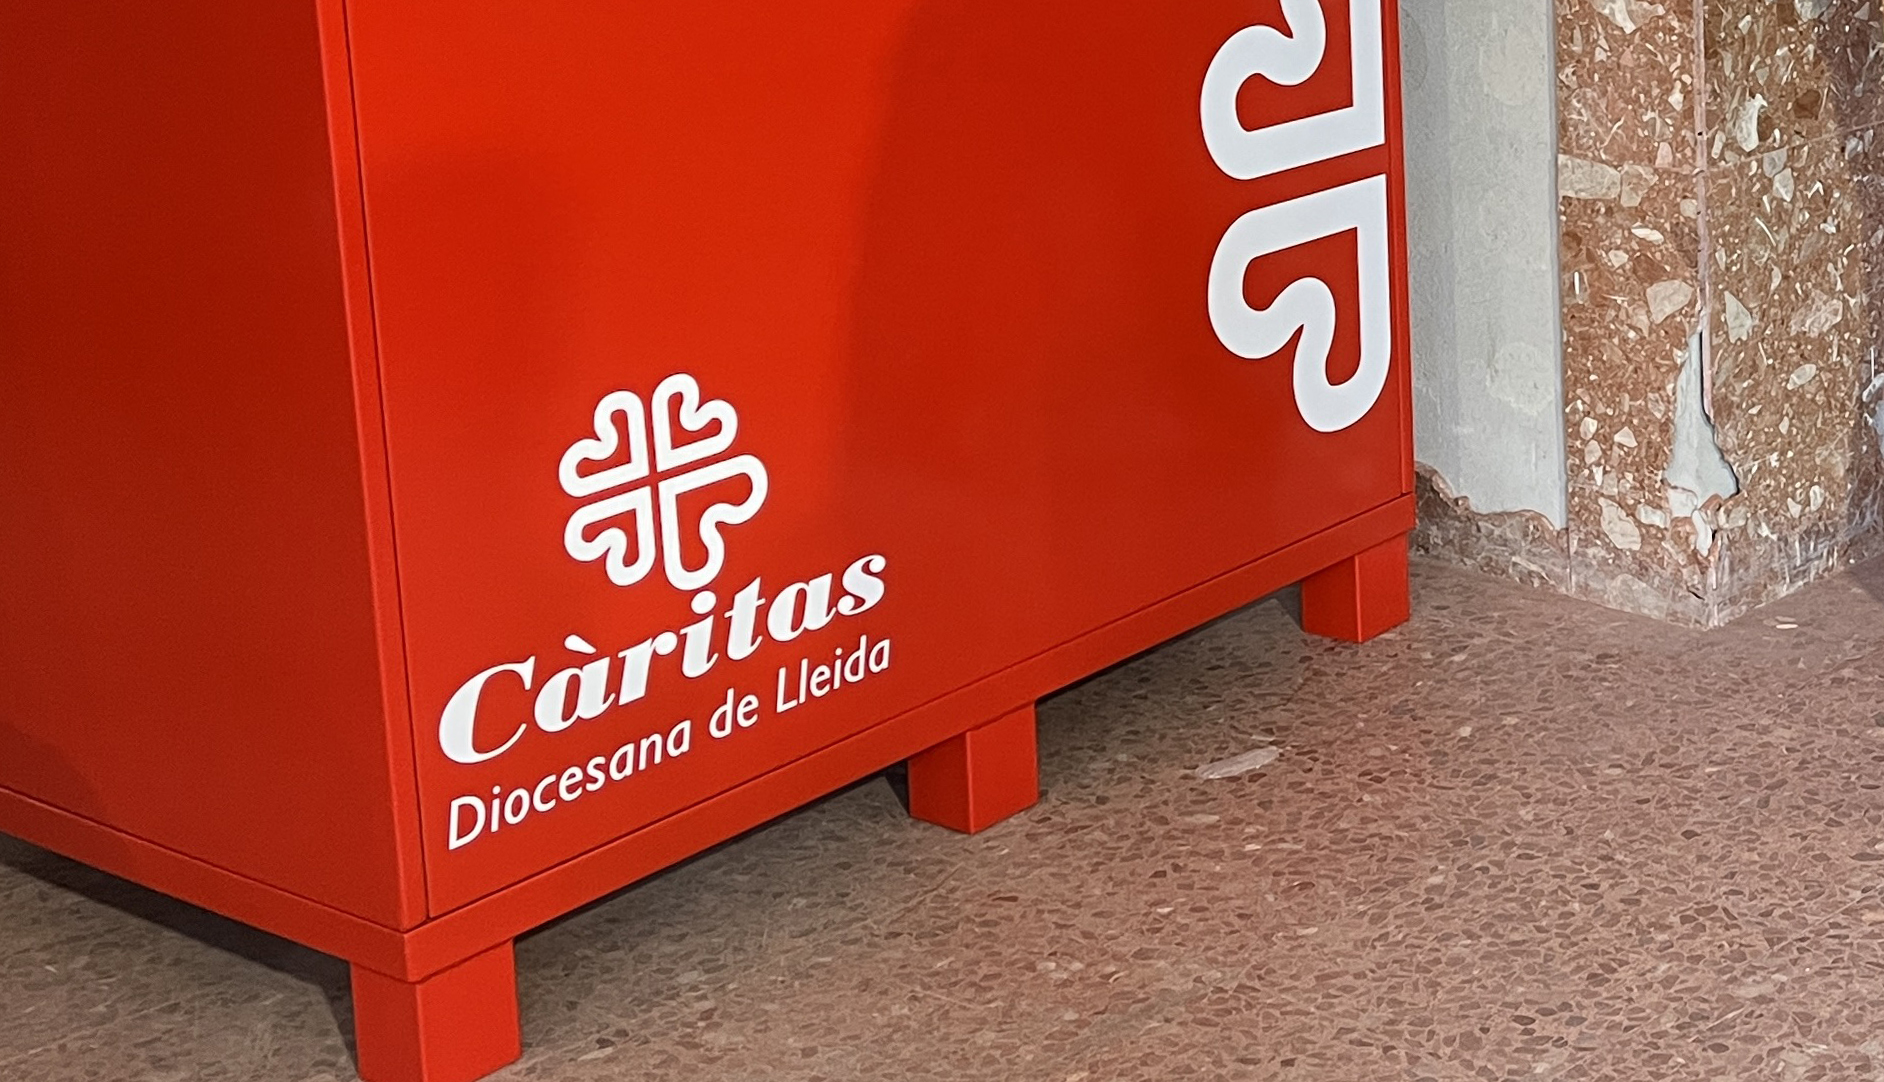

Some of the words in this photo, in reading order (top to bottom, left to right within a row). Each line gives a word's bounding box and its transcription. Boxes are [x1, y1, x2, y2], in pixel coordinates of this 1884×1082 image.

[438, 554, 887, 764] Càritas
[448, 720, 691, 851] Diocesana
[709, 688, 759, 739] de
[775, 634, 891, 714] Lleida
